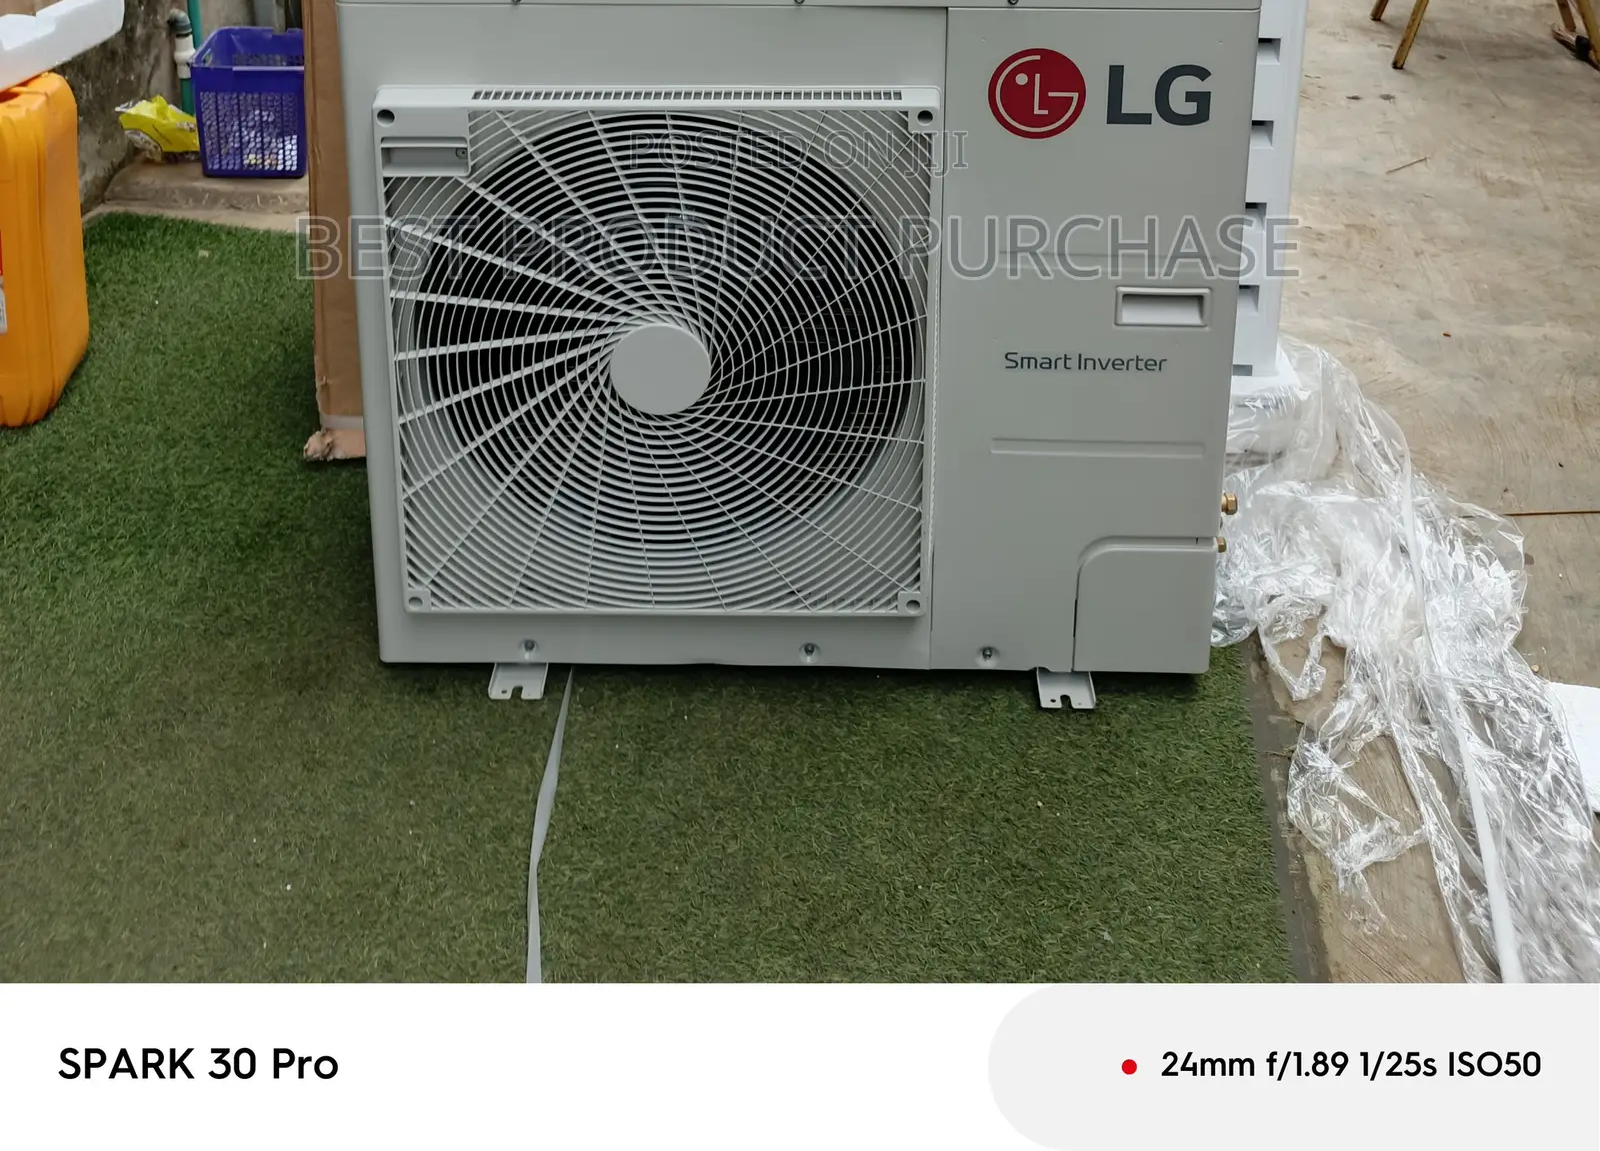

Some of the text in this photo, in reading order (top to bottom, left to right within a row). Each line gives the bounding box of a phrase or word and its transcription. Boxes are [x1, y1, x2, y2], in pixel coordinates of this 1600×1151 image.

[1106, 64, 1212, 126] LG
[1004, 352, 1168, 372] Smart Inverter
